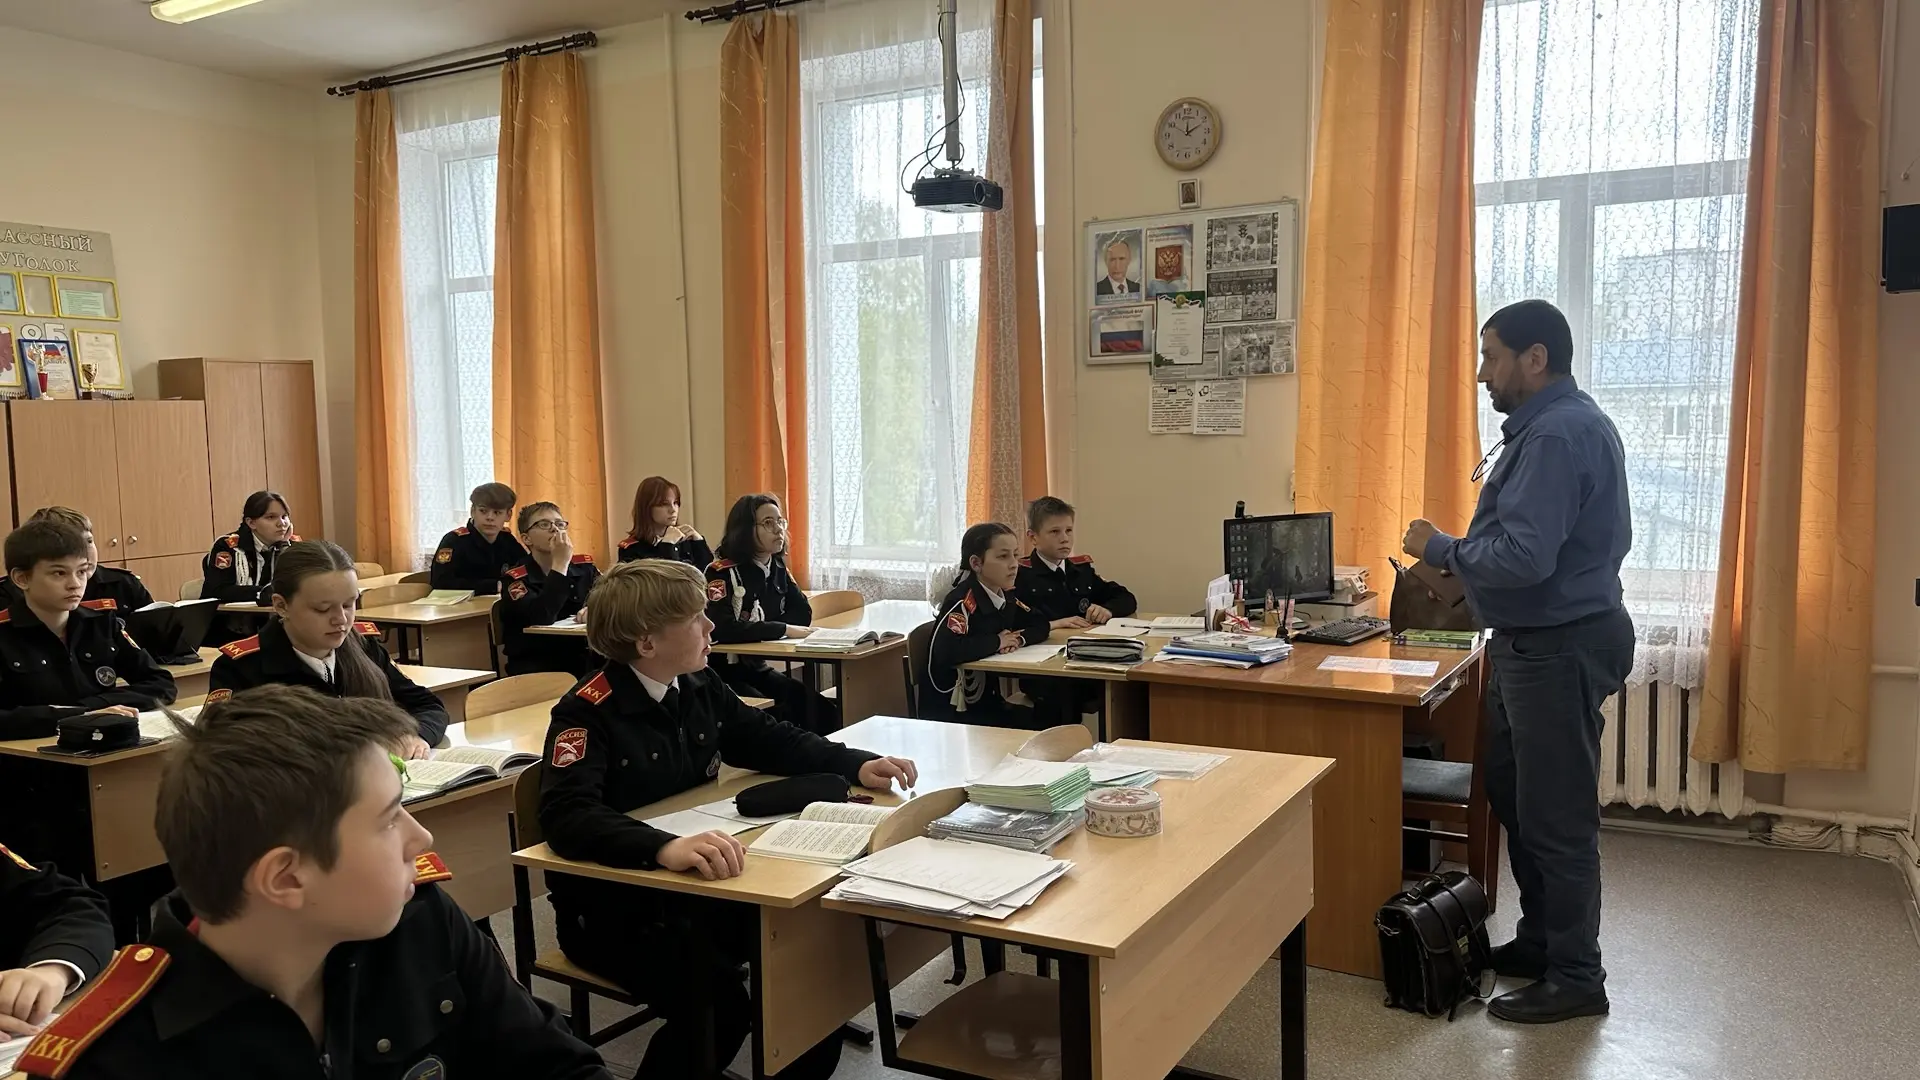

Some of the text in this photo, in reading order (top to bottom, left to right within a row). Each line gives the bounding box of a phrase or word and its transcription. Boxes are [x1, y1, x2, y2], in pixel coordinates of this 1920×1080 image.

[0, 228, 93, 252] АССНЫЙ
[0, 251, 80, 273] УГОЛОК
[583, 686, 603, 699] КК
[28, 1033, 77, 1061] КК
